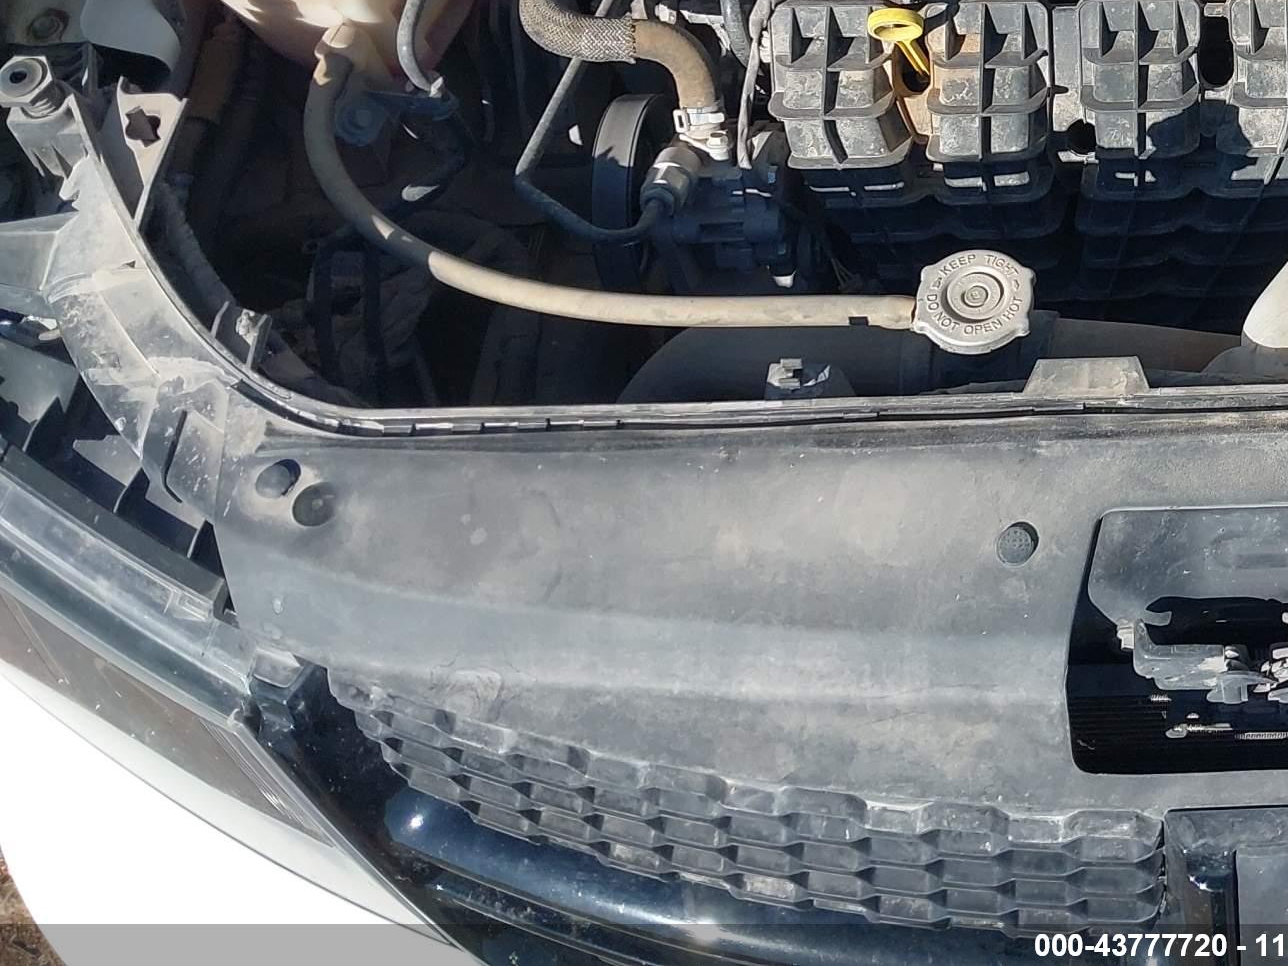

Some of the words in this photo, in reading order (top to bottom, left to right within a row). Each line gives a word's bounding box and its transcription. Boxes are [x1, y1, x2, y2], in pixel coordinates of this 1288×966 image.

[939, 253, 976, 277] KEEP
[984, 254, 1019, 277] TIGHT
[926, 293, 939, 311] DO
[934, 311, 960, 331] NOT
[963, 318, 1003, 334] OPEN
[1002, 296, 1023, 320] HOT
